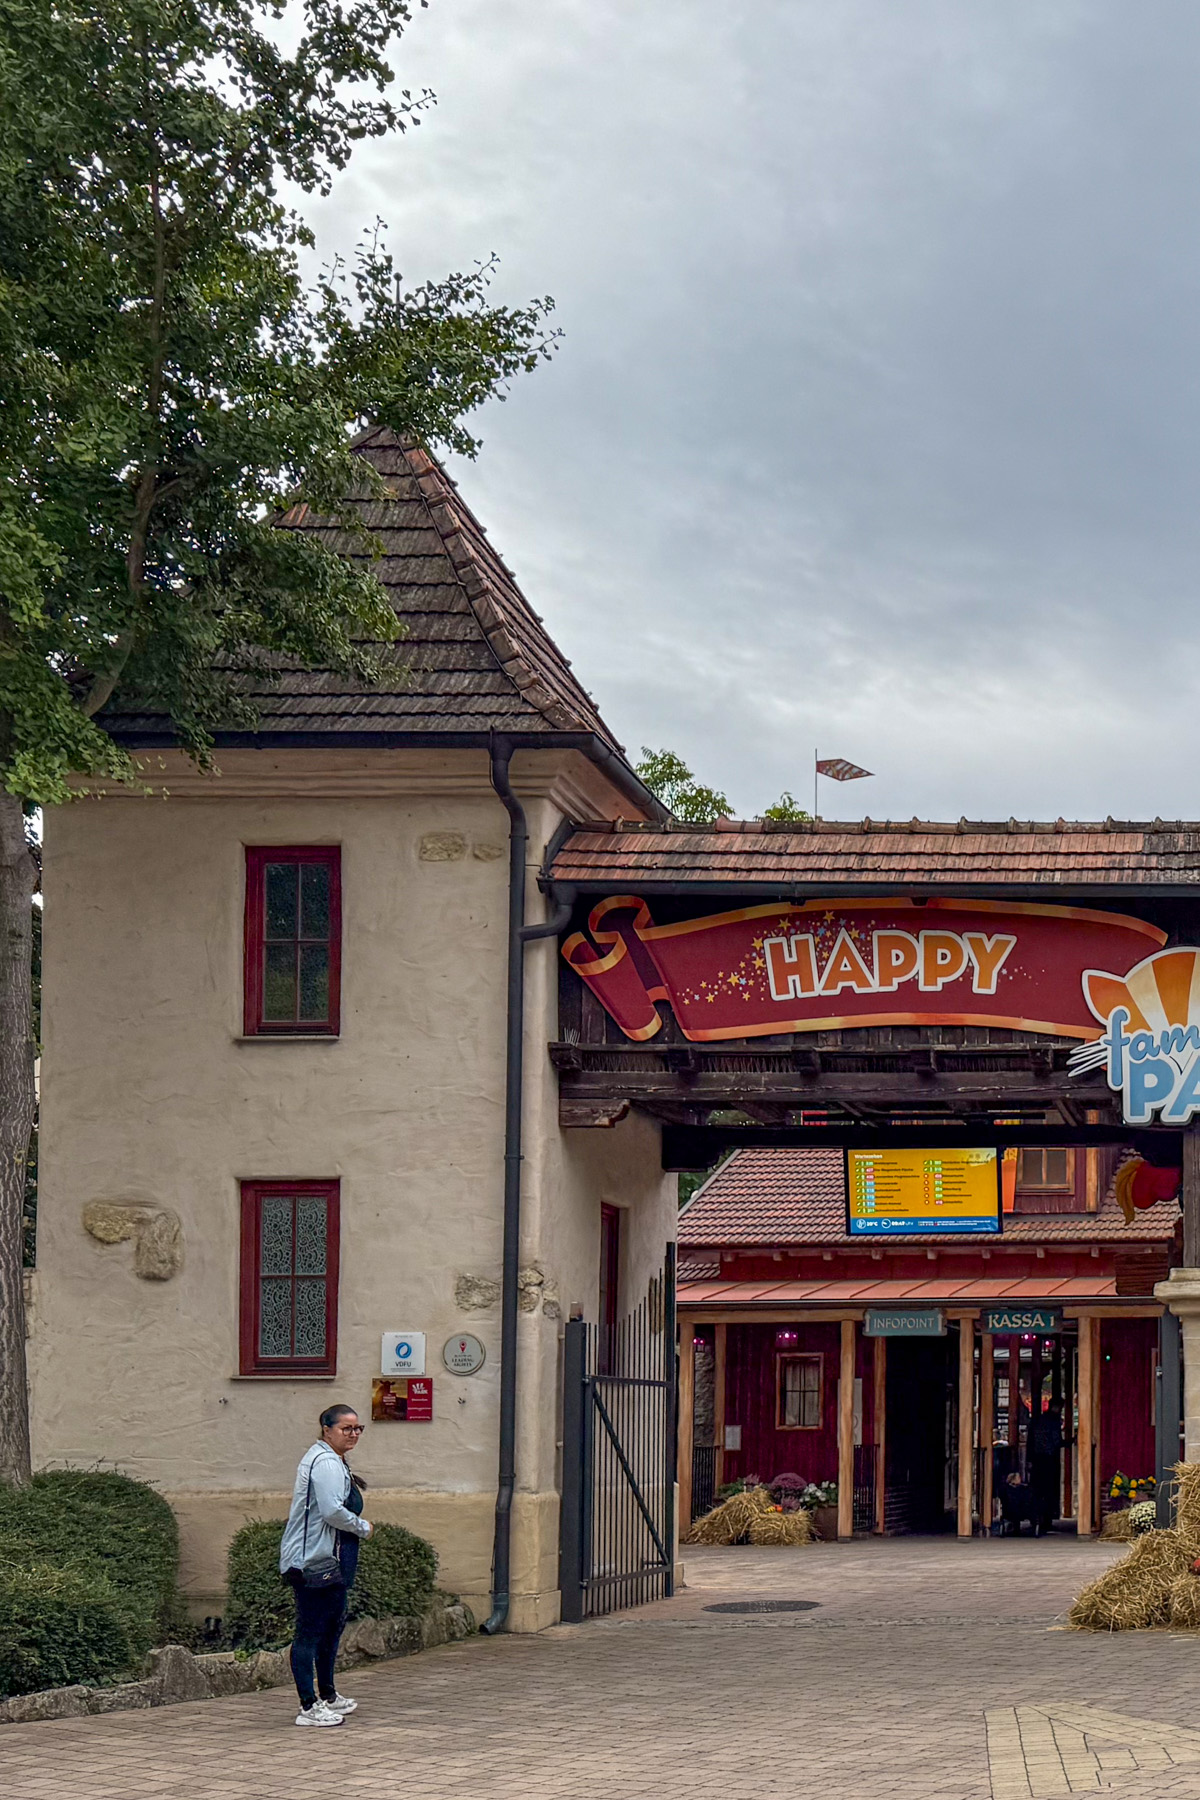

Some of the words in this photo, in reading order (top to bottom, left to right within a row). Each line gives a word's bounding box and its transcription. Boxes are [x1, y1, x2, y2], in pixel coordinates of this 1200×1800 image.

[764, 928, 1017, 1001] HAPPY
[873, 1316, 935, 1329] INFOPOINT
[988, 1313, 1046, 1329] KASSA
[1049, 1316, 1056, 1328] 1
